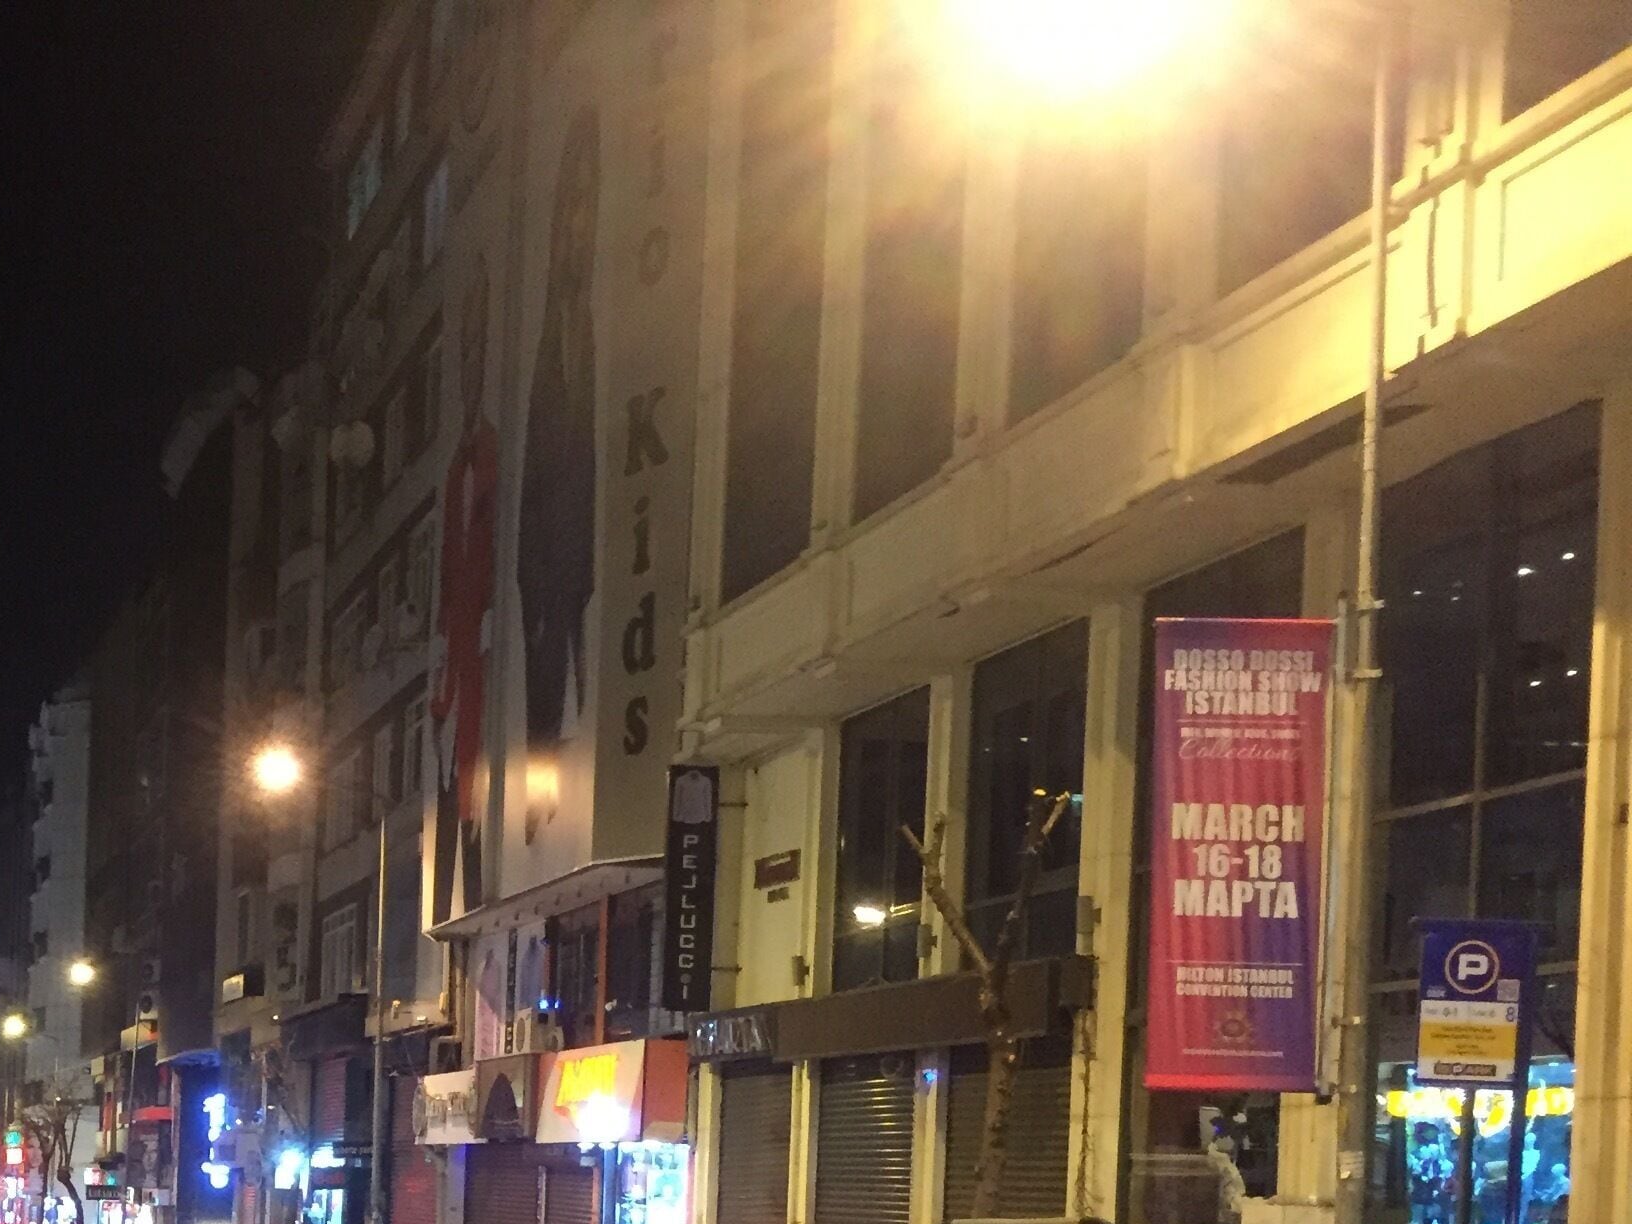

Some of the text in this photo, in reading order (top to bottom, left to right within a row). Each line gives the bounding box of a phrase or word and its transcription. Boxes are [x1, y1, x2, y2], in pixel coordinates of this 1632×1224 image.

[622, 385, 669, 758] Kids
[1173, 648, 1315, 672] DOSSO DOSSI
[1164, 670, 1322, 692] FASHION SHOW
[1171, 802, 1306, 842] MARCH
[1192, 843, 1282, 880] 16-18
[1175, 966, 1224, 983] HILTON
[1457, 953, 1489, 981] P
[1175, 983, 1294, 999] CONVENTION CENTER
